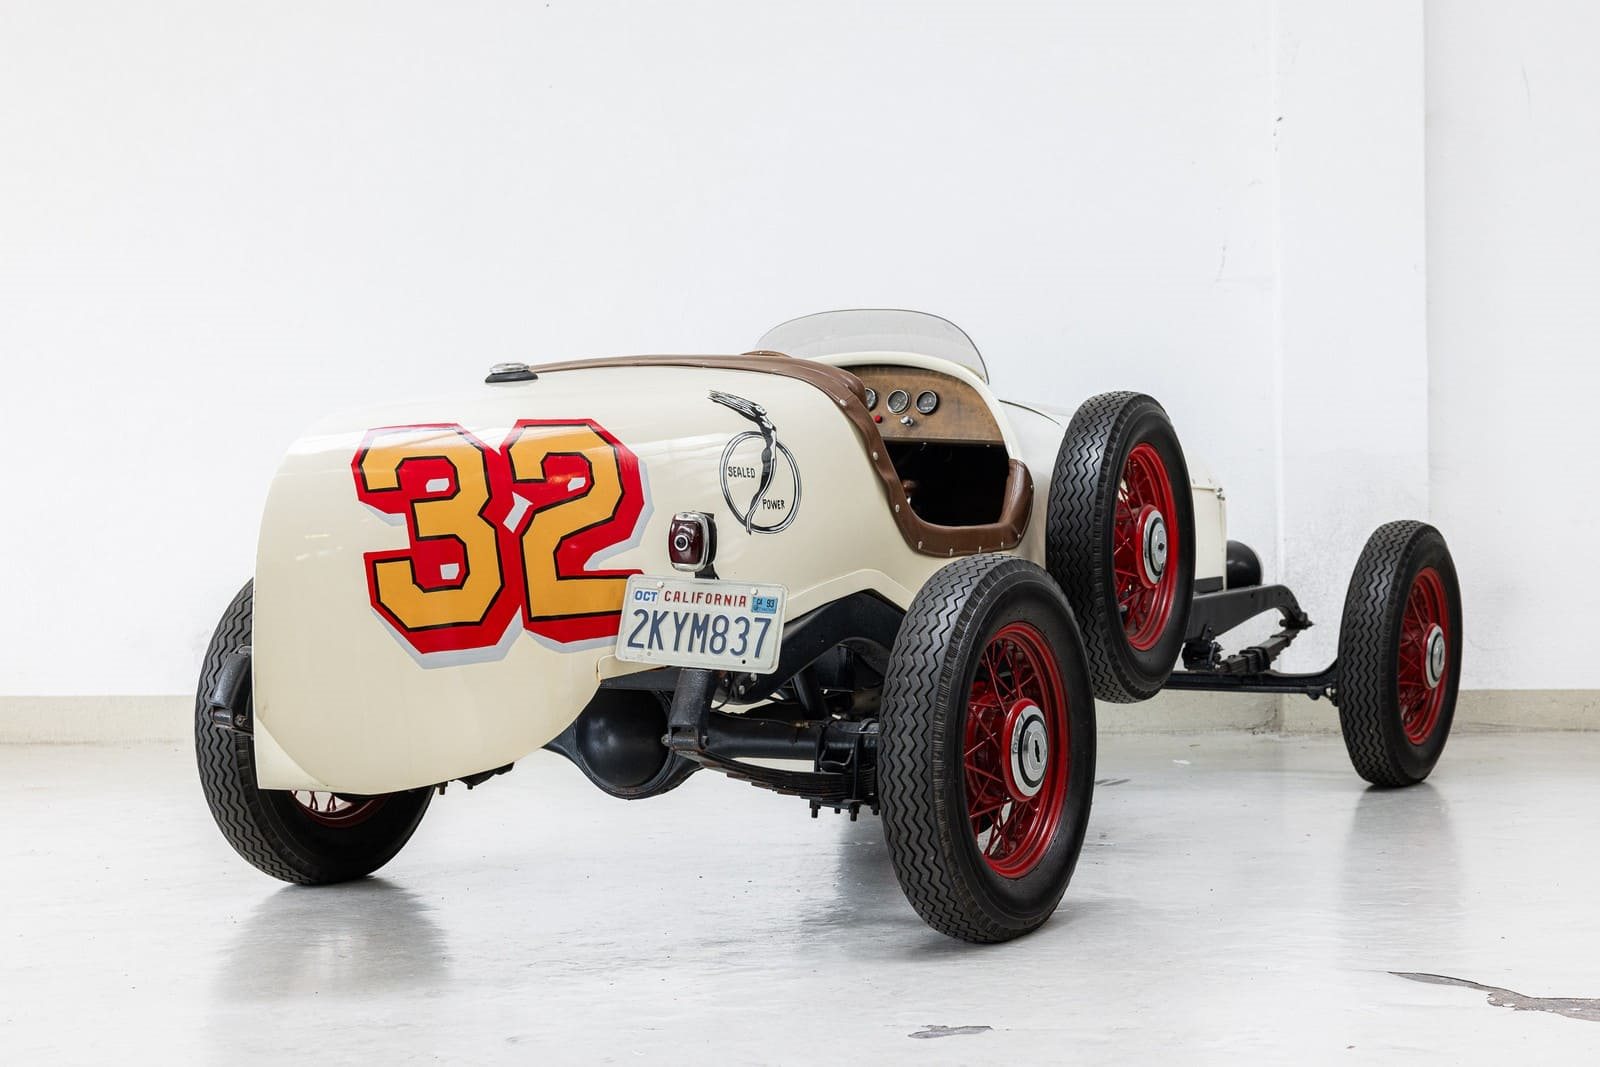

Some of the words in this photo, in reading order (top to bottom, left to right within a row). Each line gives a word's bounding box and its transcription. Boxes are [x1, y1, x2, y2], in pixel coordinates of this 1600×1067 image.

[727, 466, 756, 478] SEALED
[762, 499, 786, 510] POWER
[351, 419, 648, 660] 32
[634, 590, 658, 602] OCT
[664, 590, 747, 608] CALIFORNIA
[766, 599, 775, 608] 93
[627, 608, 772, 658] 2KYM837
